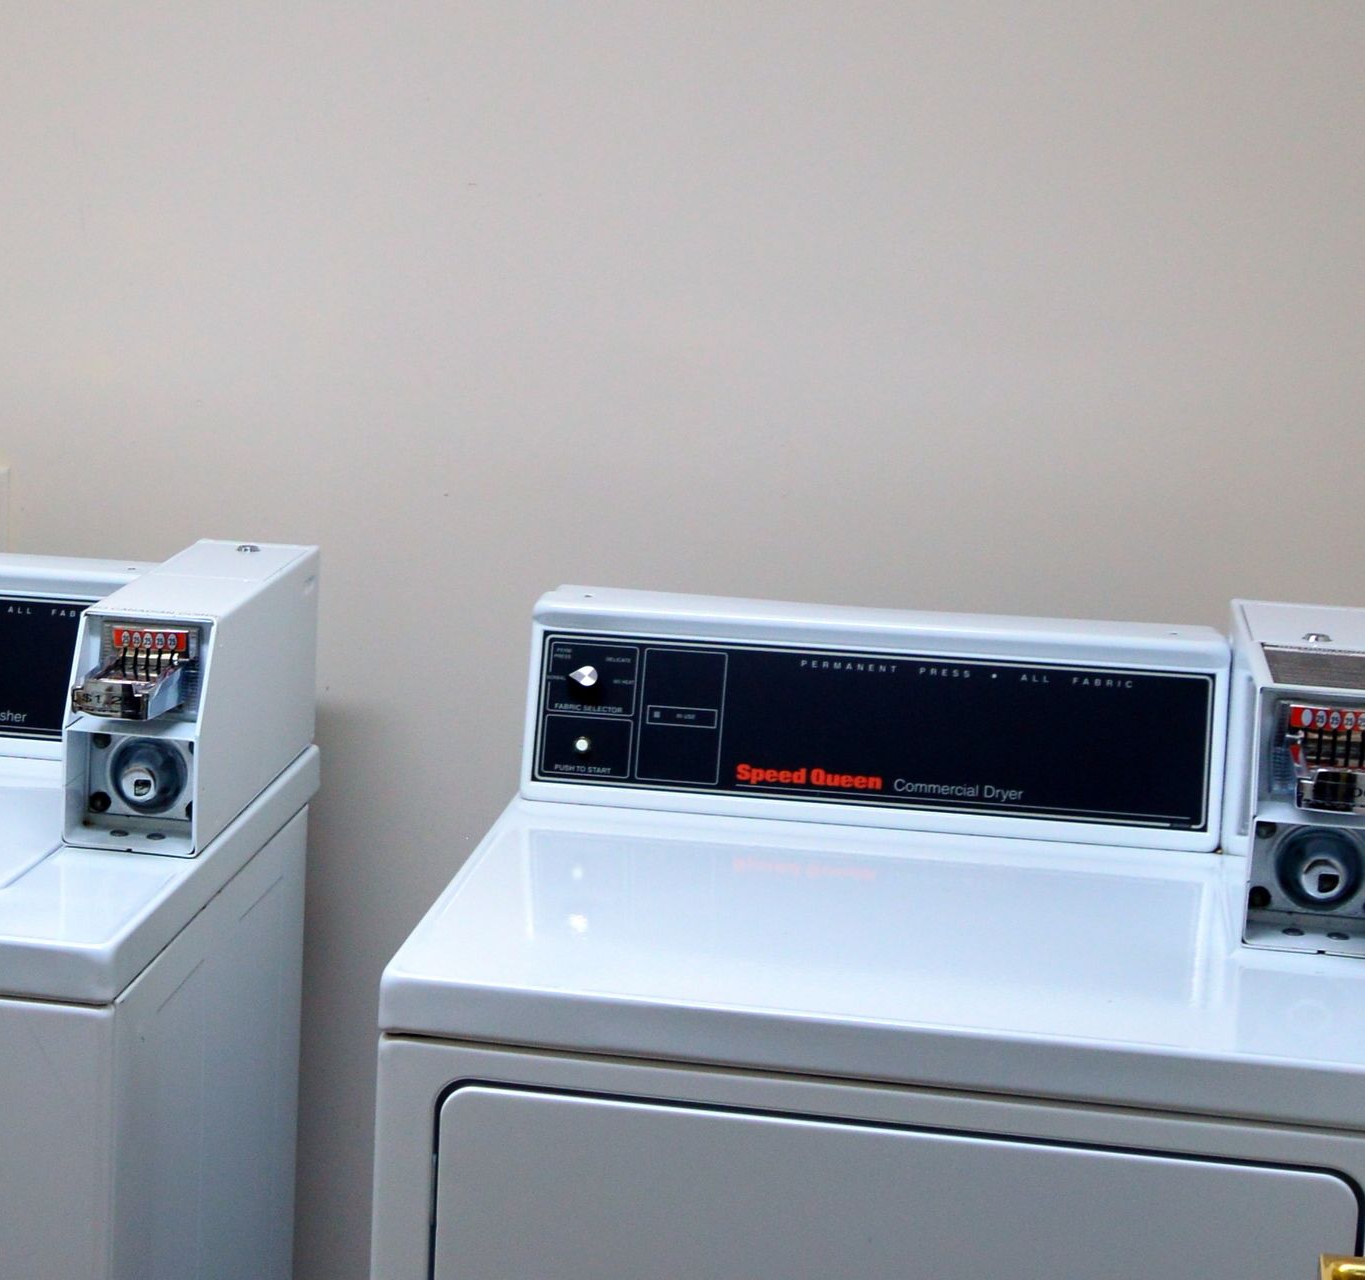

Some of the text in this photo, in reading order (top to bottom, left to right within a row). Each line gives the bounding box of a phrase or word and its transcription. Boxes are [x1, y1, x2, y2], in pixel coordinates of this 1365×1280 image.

[8, 606, 33, 615] ALL
[51, 609, 78, 618] FAB
[800, 659, 1135, 690] PERMANENT PRESS ALL FABRIC
[554, 702, 624, 714] FABRIC SELECTOR
[554, 763, 611, 774] PUSH TO START
[736, 763, 1025, 801] Speed Queen Commercial Dryer
